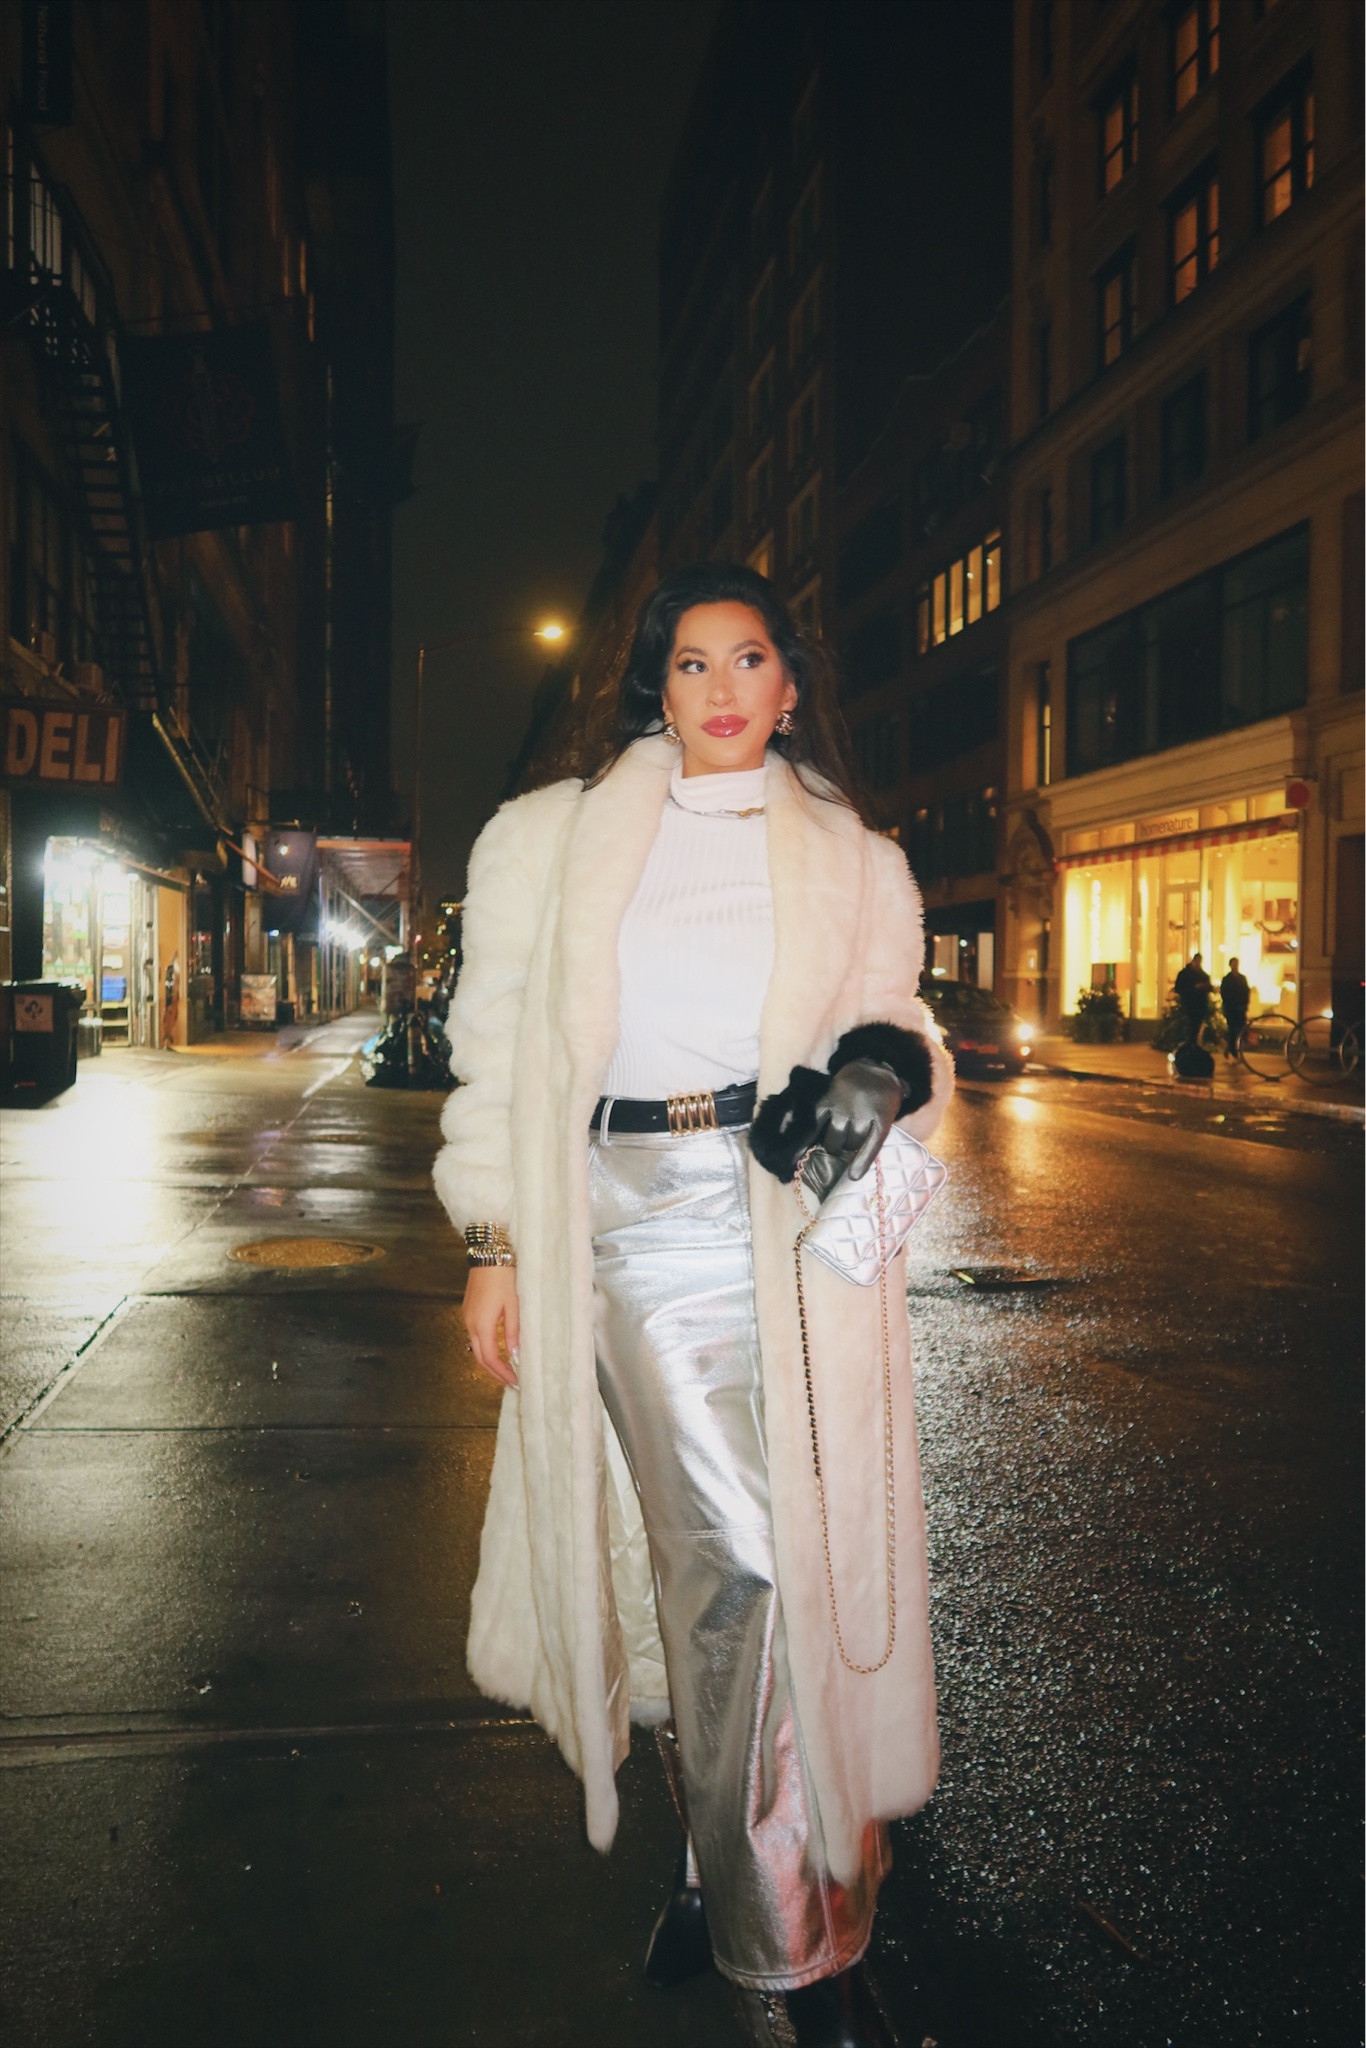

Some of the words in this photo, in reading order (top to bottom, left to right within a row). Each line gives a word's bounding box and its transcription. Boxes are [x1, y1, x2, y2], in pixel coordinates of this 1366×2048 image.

[37, 4, 49, 64] Natural
[37, 69, 49, 111] Food
[6, 708, 120, 783] DELI
[1140, 816, 1194, 837] homenature
